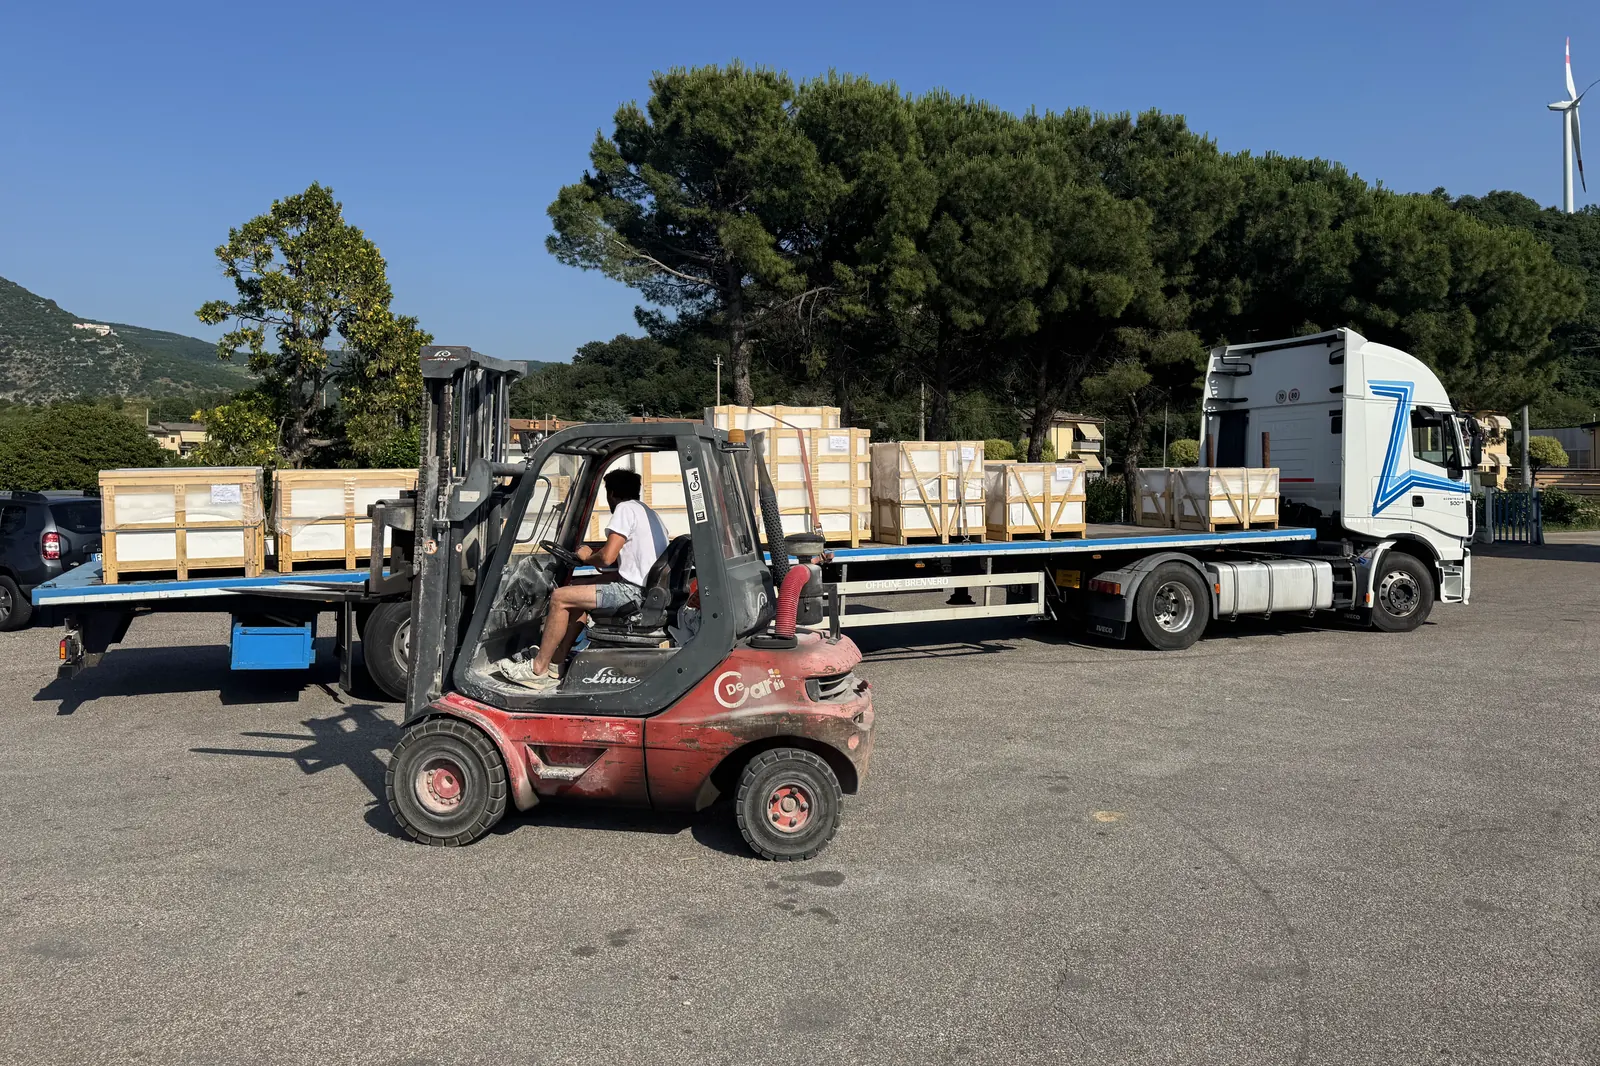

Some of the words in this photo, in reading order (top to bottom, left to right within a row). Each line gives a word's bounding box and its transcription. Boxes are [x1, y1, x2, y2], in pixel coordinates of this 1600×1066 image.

[865, 580, 902, 589] OFFICINE
[905, 577, 949, 587] BRENNERO
[1096, 624, 1113, 634] IVECO
